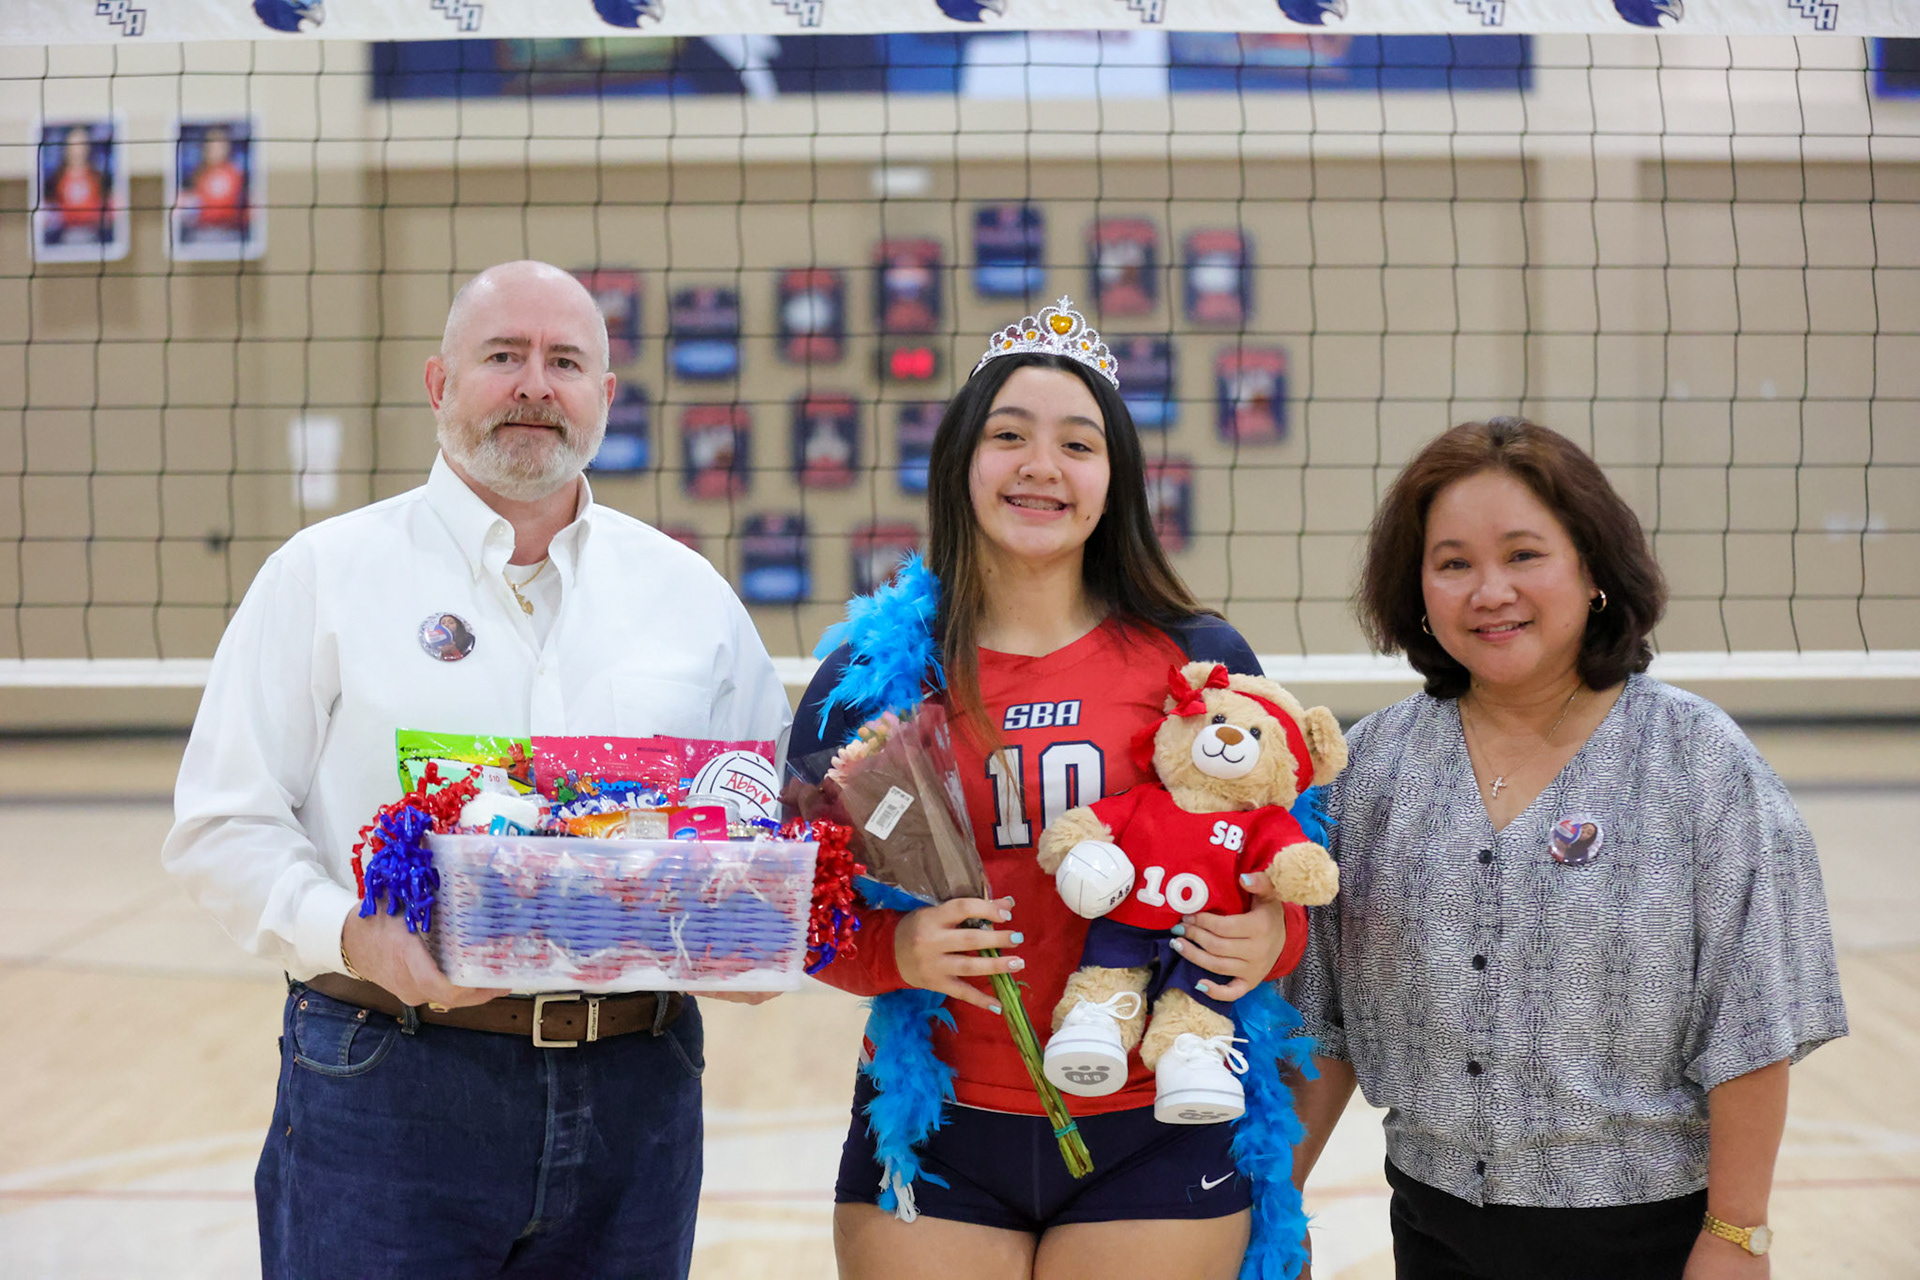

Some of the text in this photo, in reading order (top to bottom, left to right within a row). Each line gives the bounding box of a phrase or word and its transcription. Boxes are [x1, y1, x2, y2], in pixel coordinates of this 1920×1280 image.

[1003, 699, 1082, 731] SBA
[725, 771, 763, 805] Abby
[984, 740, 1105, 850] 10
[1209, 820, 1246, 853] SB
[1136, 865, 1209, 915] 10
